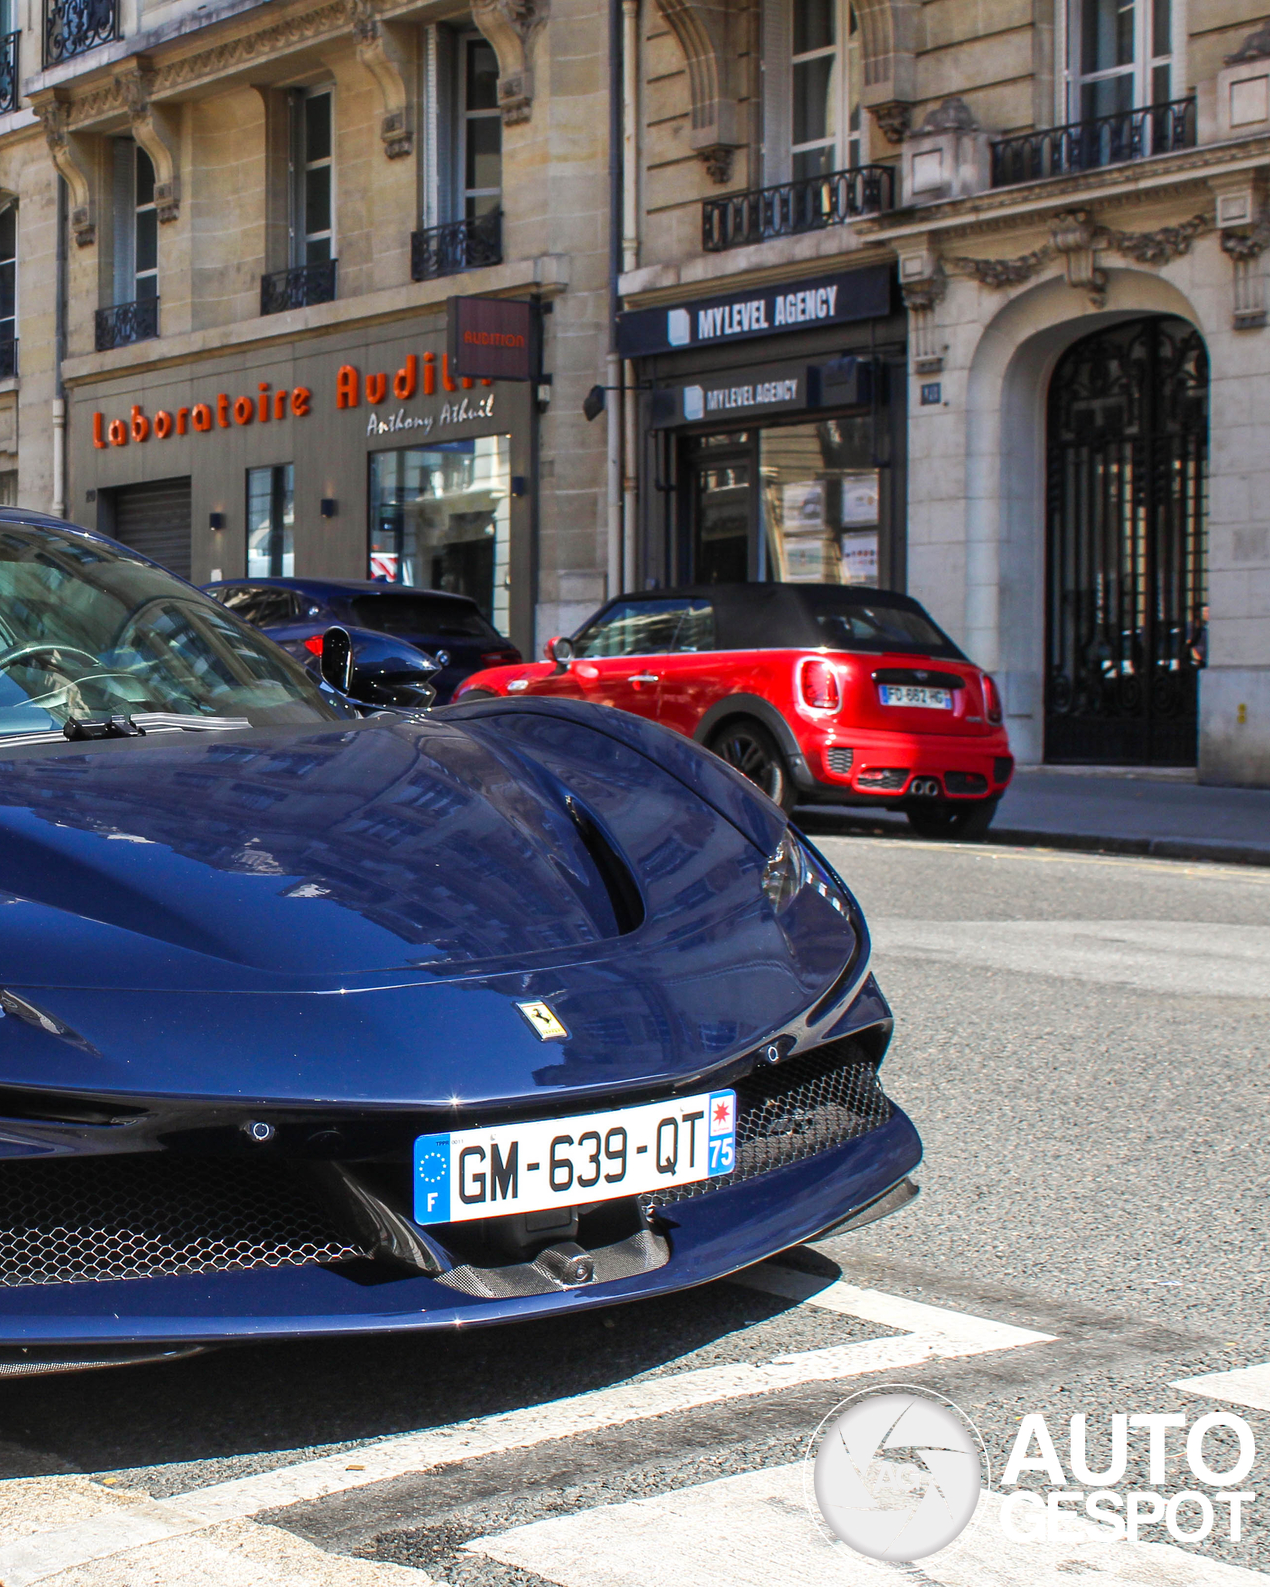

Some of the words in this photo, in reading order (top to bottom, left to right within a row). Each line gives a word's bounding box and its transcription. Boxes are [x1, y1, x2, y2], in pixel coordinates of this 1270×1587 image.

[698, 299, 769, 340] MYLEVEL
[774, 284, 838, 327] AGENCY
[463, 330, 525, 348] AUDITION
[706, 385, 755, 411] MYLEVEL
[755, 378, 798, 404] AGENCY
[92, 381, 311, 449] Laboratoire
[366, 408, 434, 437] Anthony
[458, 1110, 705, 1205] GM-639-QT
[709, 1137, 734, 1169] 75
[427, 1192, 439, 1212] F
